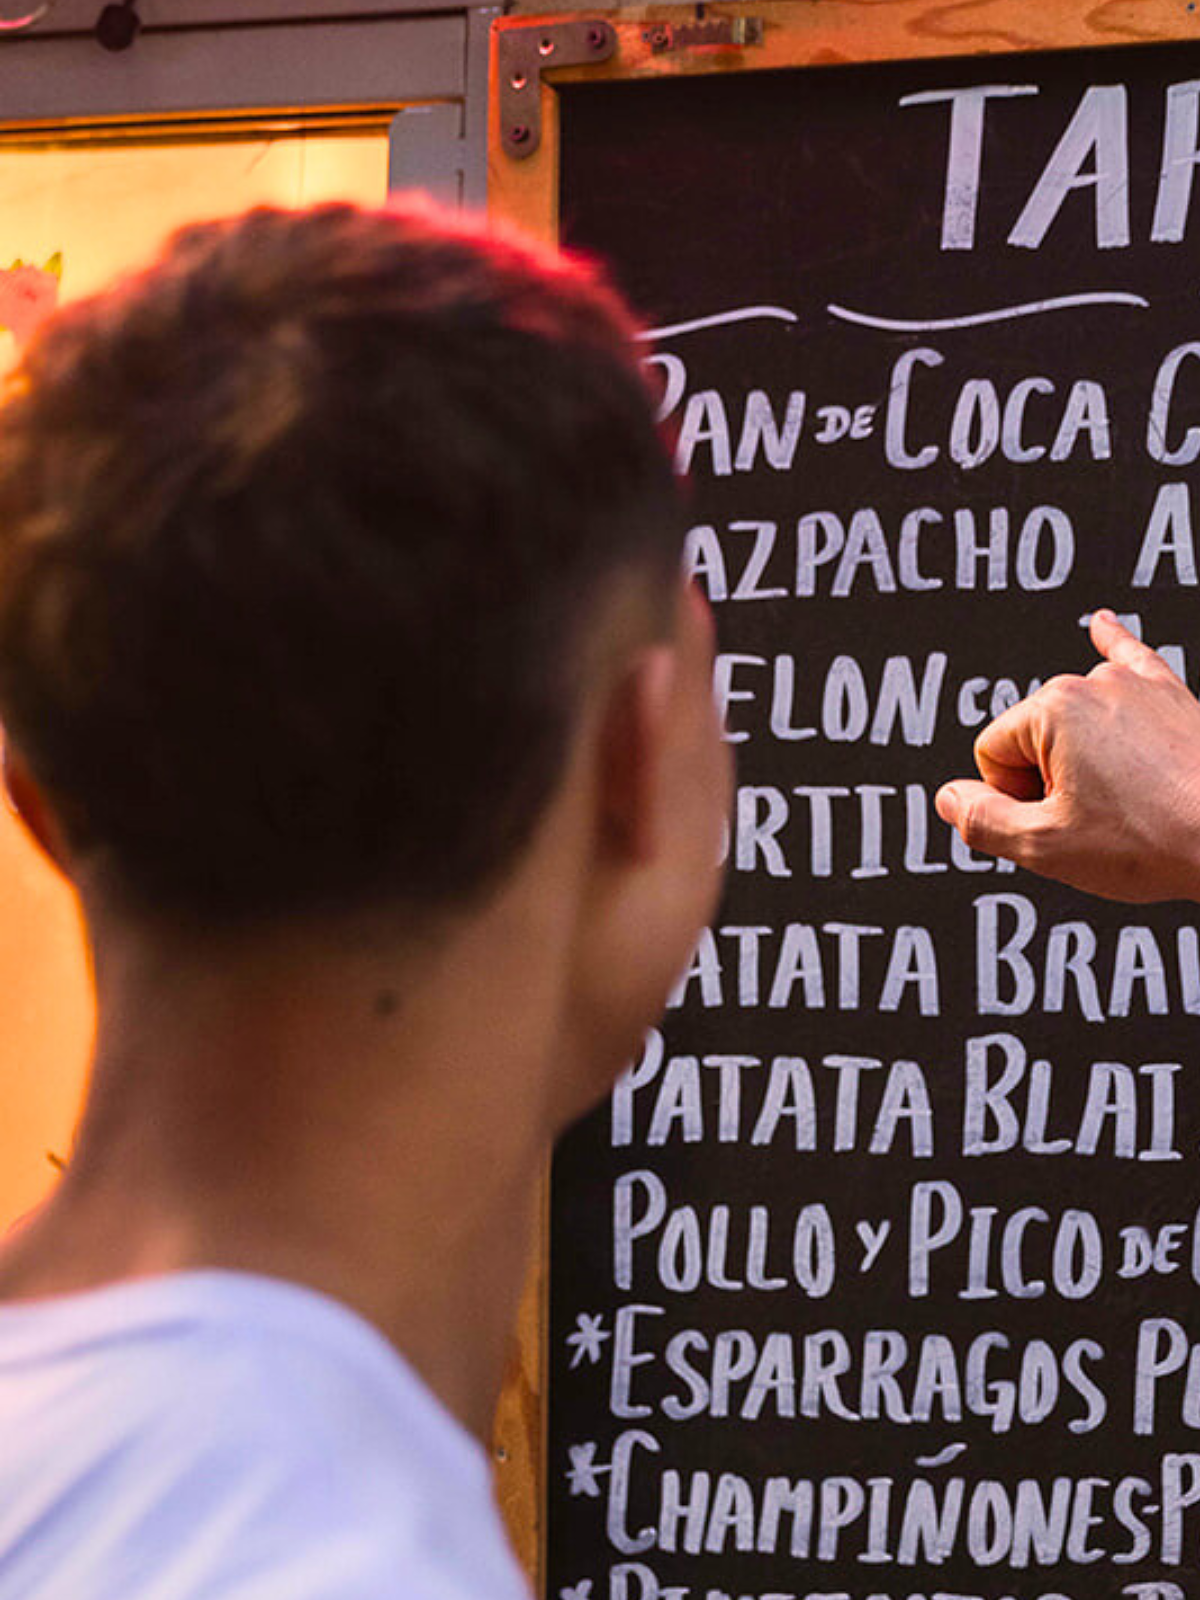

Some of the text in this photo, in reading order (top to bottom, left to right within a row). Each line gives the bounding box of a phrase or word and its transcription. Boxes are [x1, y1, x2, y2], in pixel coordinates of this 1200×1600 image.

[816, 406, 877, 444] DE
[886, 349, 1112, 471] COCA
[685, 506, 1076, 603] AZPACHO
[713, 653, 949, 748] ELON
[958, 678, 1043, 728] CO
[664, 923, 940, 1017] ATATA
[612, 1026, 934, 1159] PATATA
[963, 1034, 1184, 1163] BLAI
[614, 1171, 836, 1299] POLLO
[910, 1181, 1103, 1300] PICO
[1118, 1225, 1189, 1279] DE
[611, 1305, 1108, 1433] ESPARRAGOS
